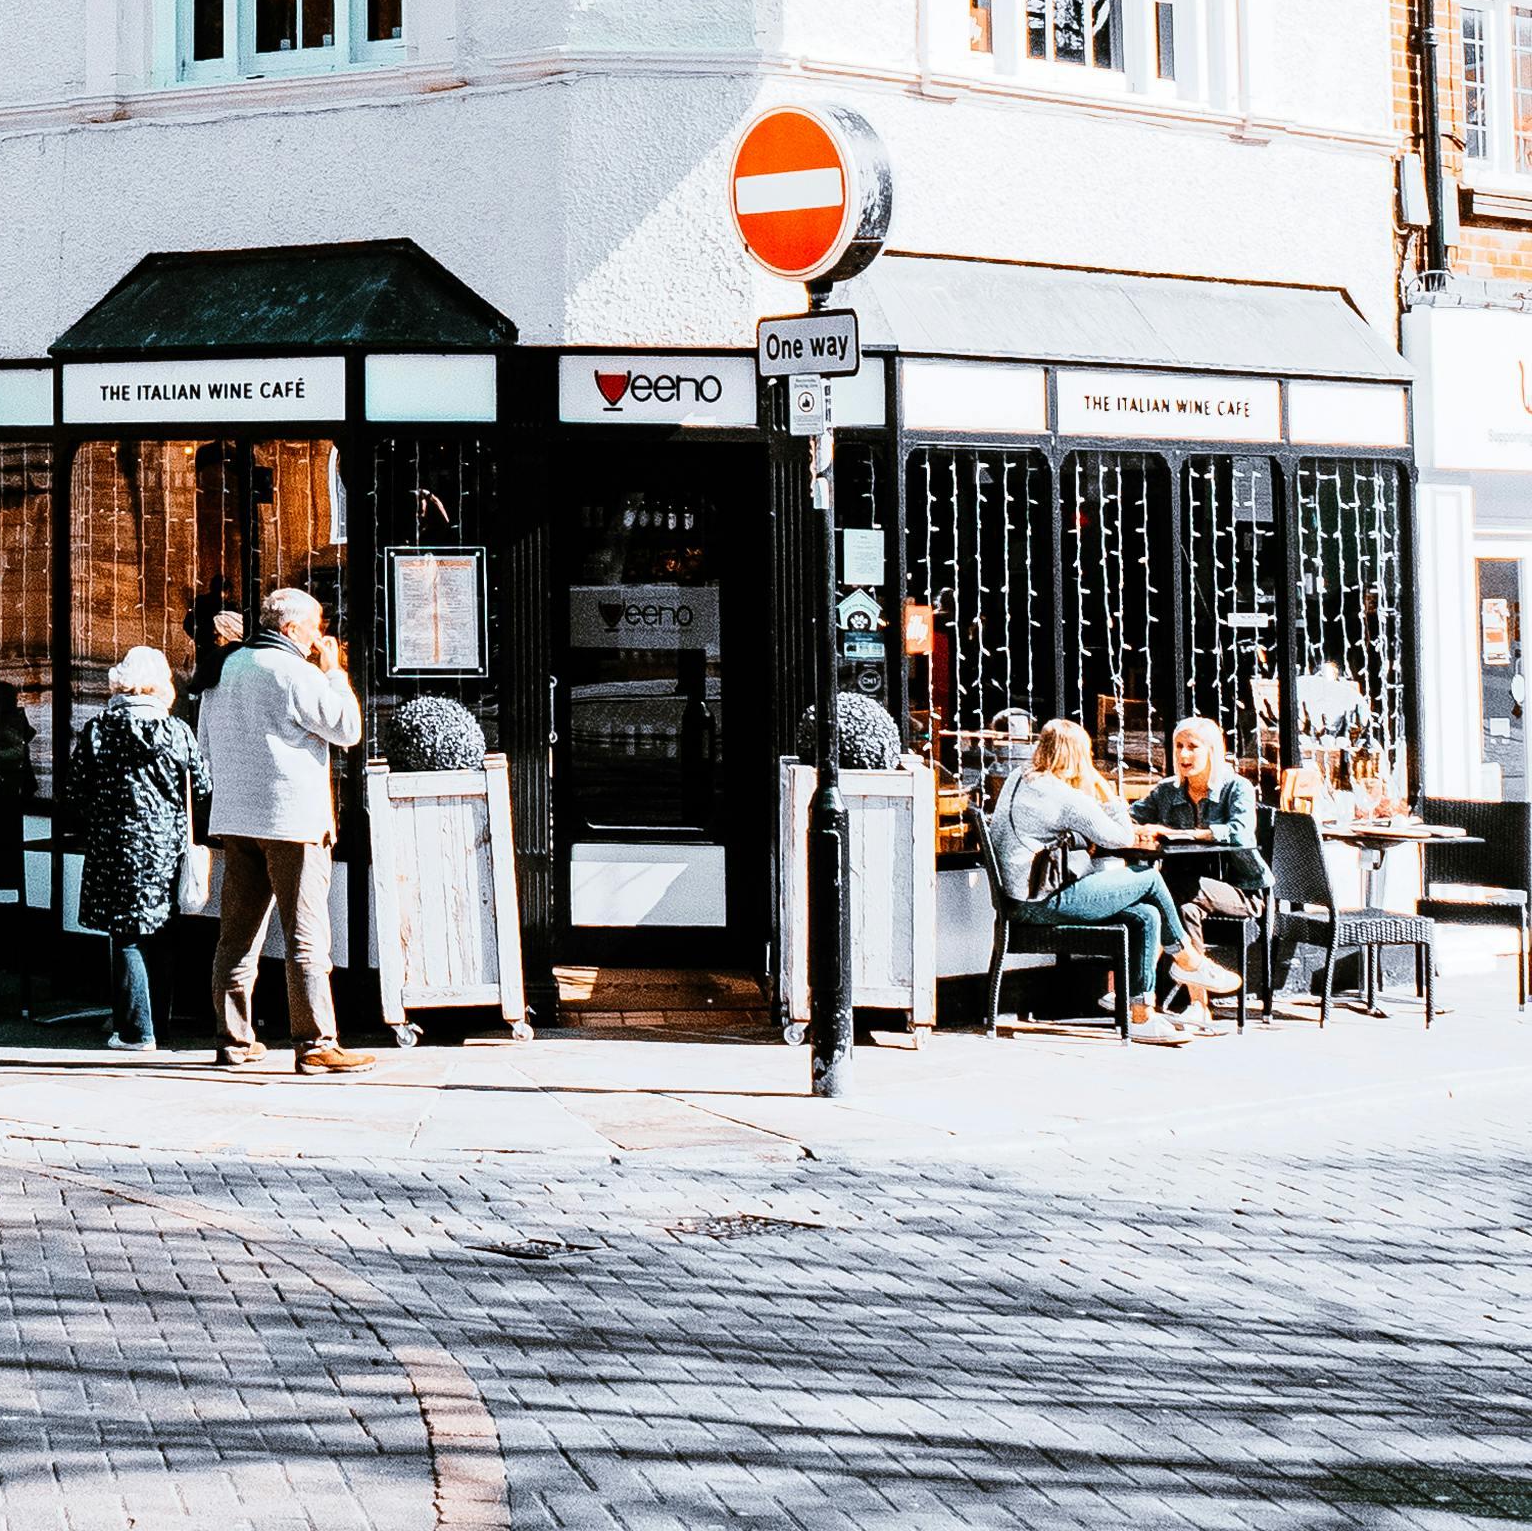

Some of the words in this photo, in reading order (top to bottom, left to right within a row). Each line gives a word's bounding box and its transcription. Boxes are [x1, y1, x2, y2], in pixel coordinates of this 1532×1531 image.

[766, 332, 803, 360] One
[809, 335, 848, 361] way
[100, 385, 130, 401] THE
[137, 384, 201, 400] ITALIAN
[208, 382, 253, 399] WINE
[259, 377, 305, 399] CAFÉ
[1084, 395, 1110, 411] THE
[1117, 396, 1169, 413] ITALIAN
[1176, 398, 1211, 416] WINE
